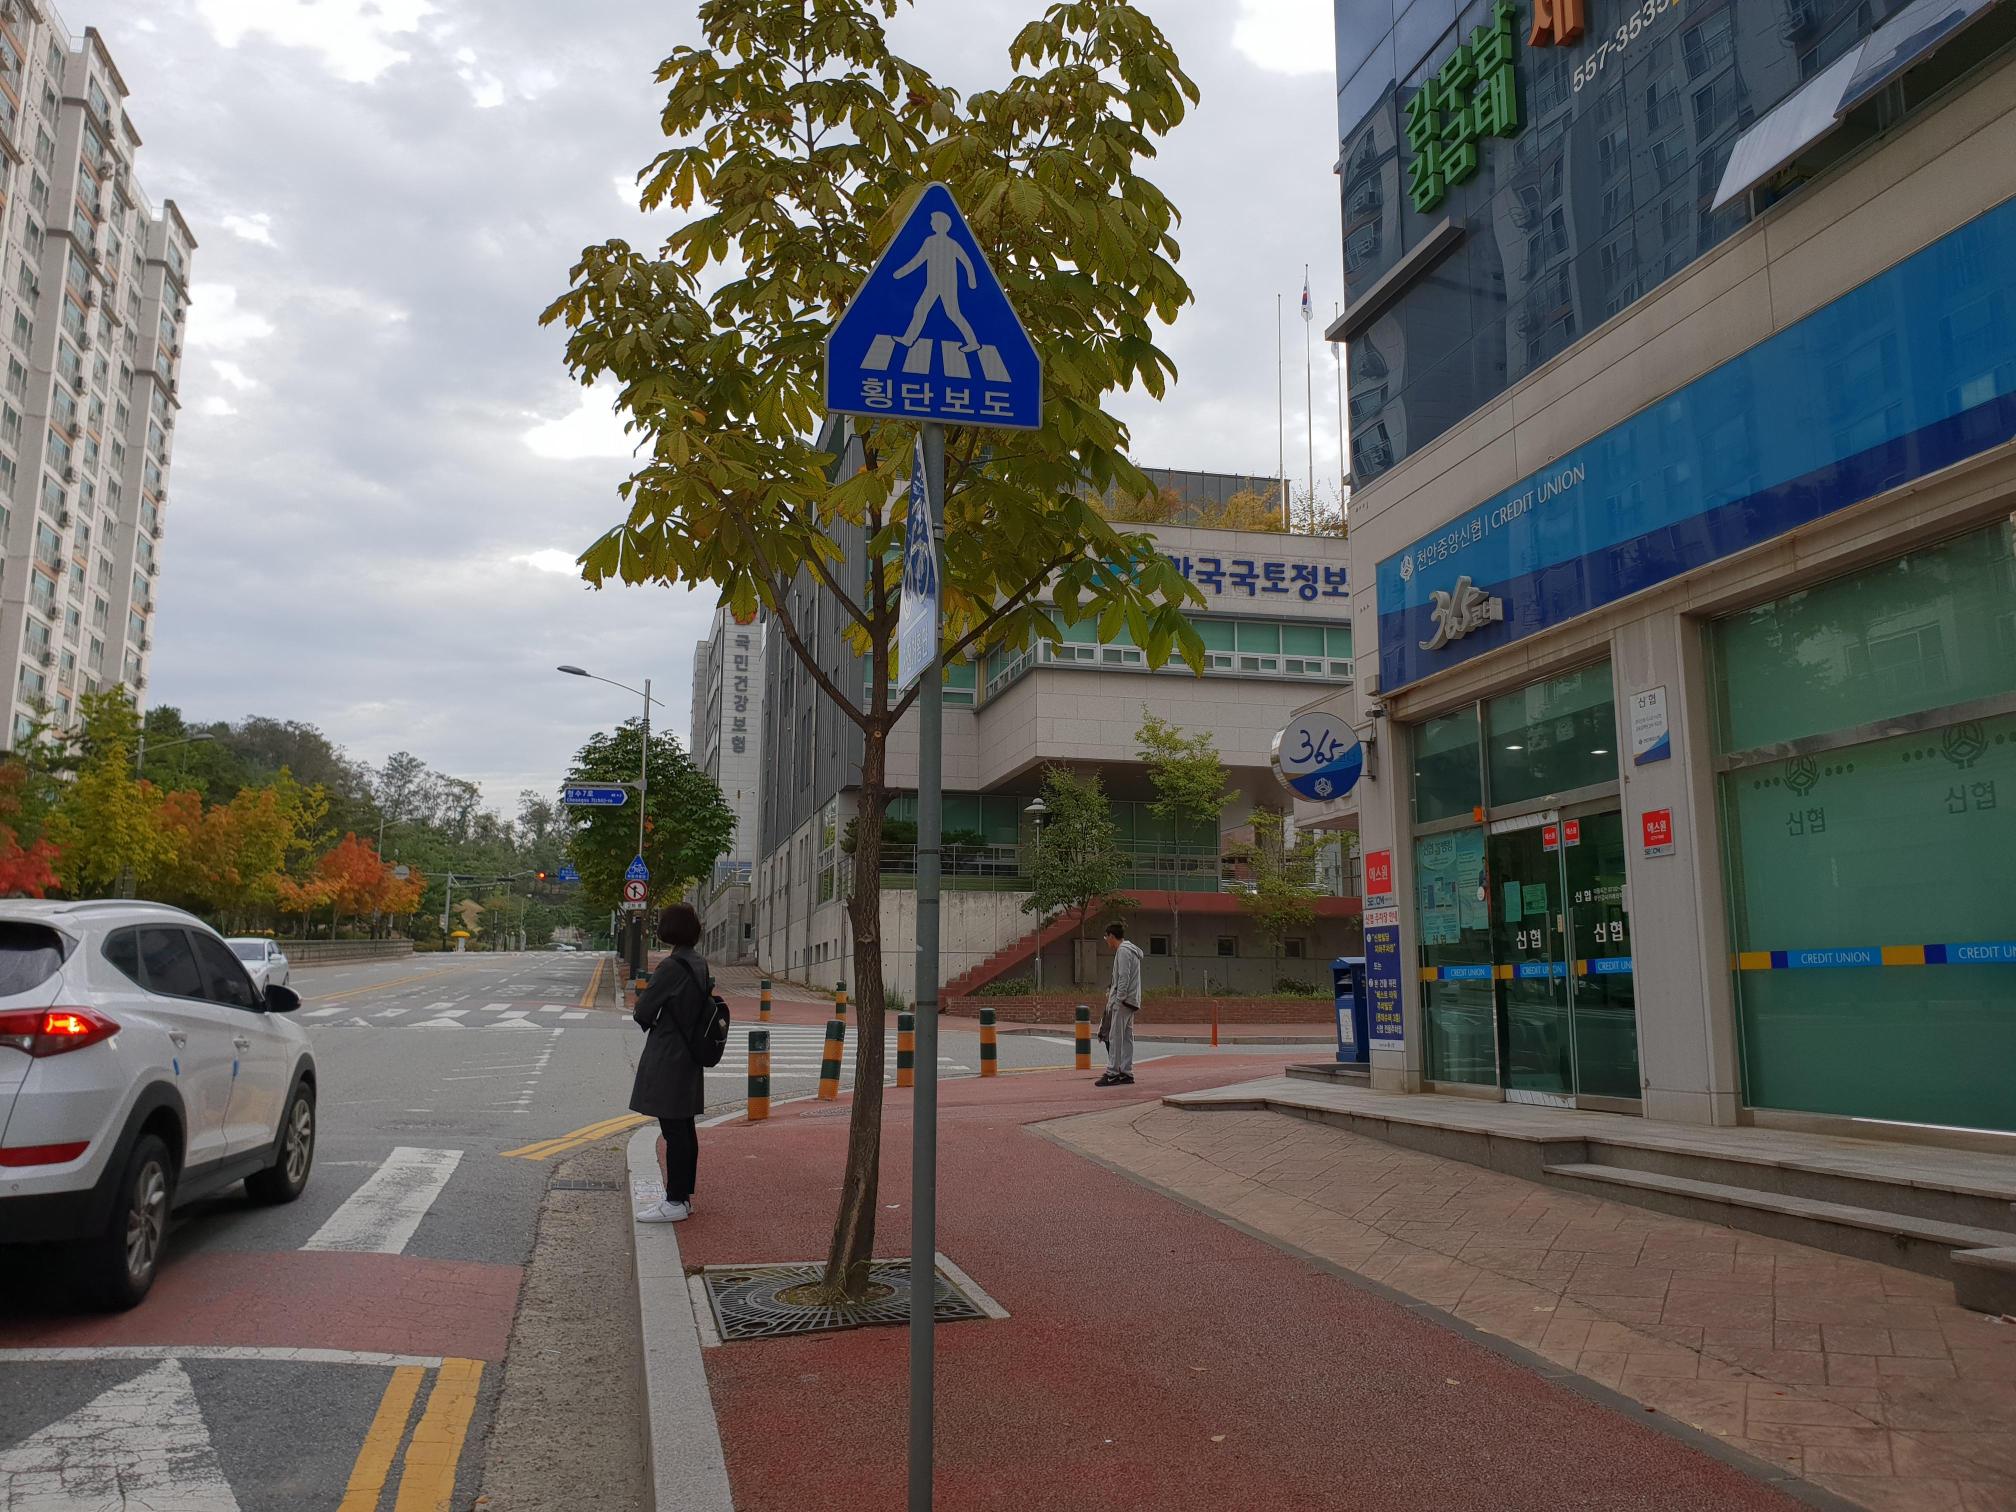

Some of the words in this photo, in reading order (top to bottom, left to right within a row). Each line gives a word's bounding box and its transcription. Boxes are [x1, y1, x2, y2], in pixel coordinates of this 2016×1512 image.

[860, 377, 1015, 417] 횡단보도
[1416, 519, 1482, 572] 천안중앙신협
[1491, 491, 1534, 529] CREDIT
[1537, 463, 1585, 503] UNION
[731, 634, 751, 754] 국민건강보험
[1638, 692, 1657, 709] 신협
[1289, 728, 1345, 764] 365
[1944, 779, 1997, 815] 신협
[1785, 807, 1827, 837] 신협
[1368, 864, 1389, 882] 에스원
[1575, 889, 1592, 903] 신협
[1516, 928, 1542, 950] 신협
[1594, 920, 1624, 943] 신협
[1801, 953, 1832, 965] CREDIT
[1836, 951, 1871, 963] UNION
[1959, 946, 2000, 959] CREDIT
[1451, 968, 1467, 976] CREDIT
[1467, 968, 1485, 976] UNION
[1521, 966, 1541, 975] CREDIT
[1598, 963, 1619, 971] CREDIT
